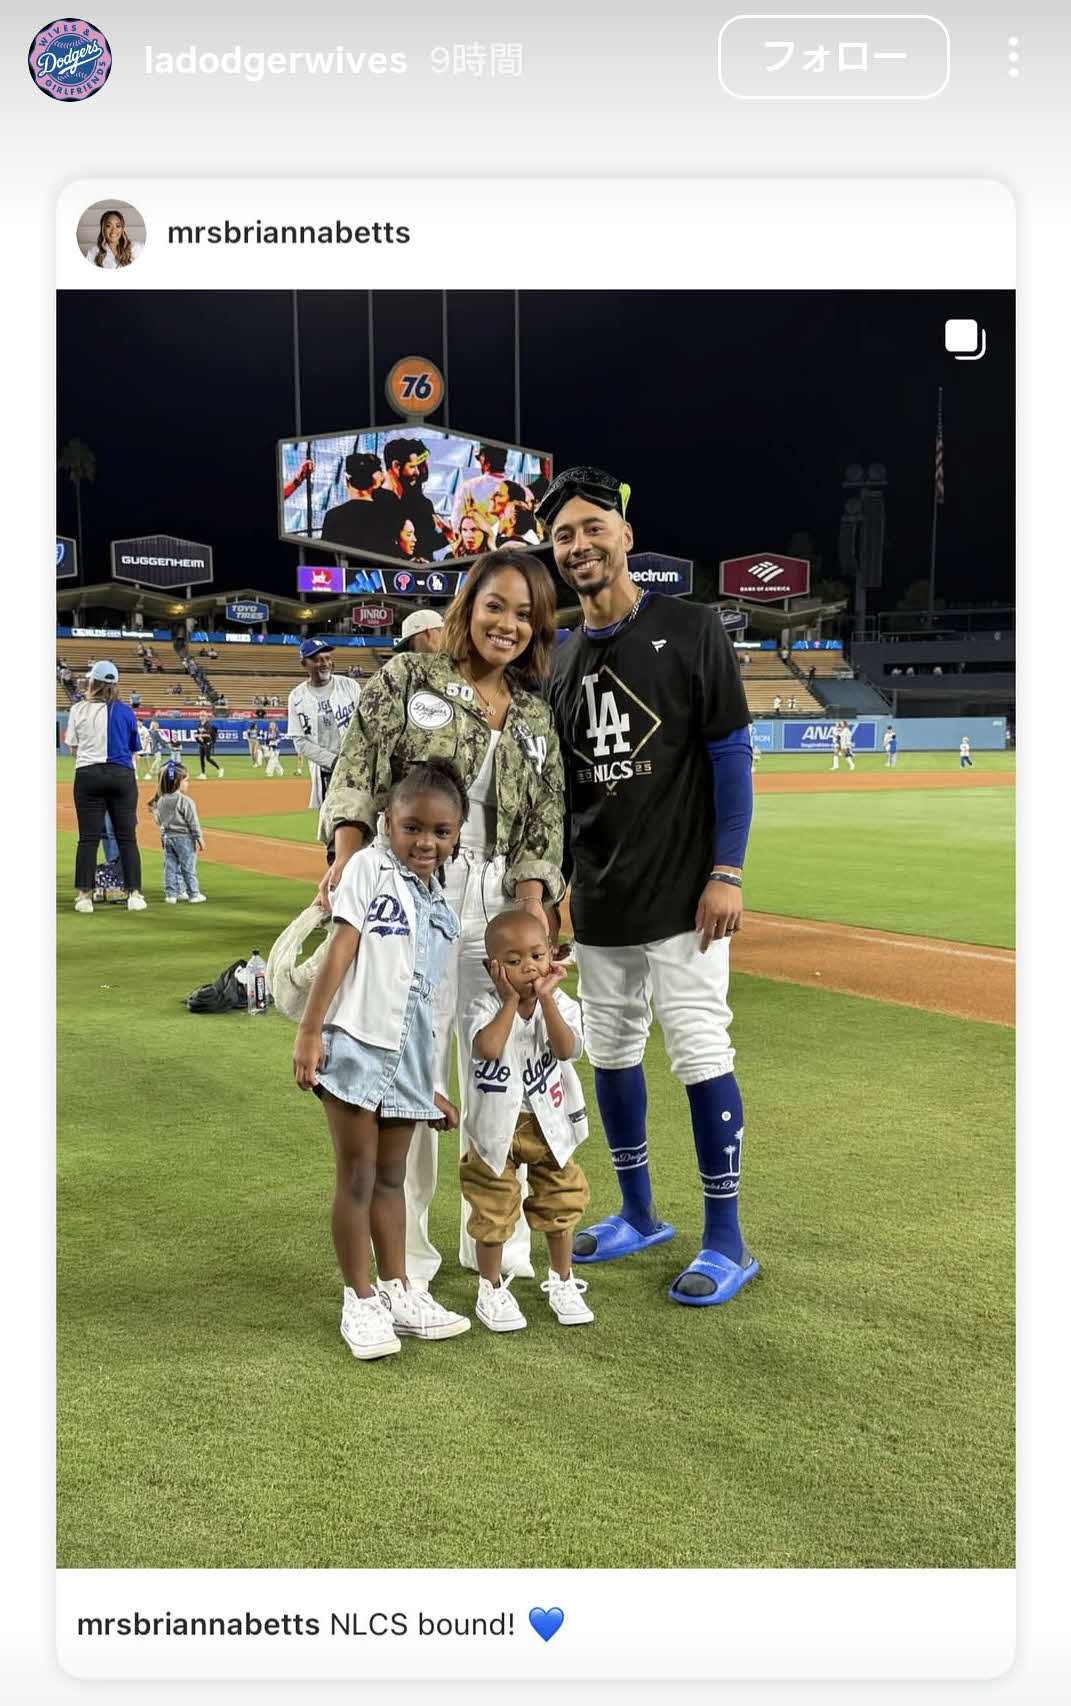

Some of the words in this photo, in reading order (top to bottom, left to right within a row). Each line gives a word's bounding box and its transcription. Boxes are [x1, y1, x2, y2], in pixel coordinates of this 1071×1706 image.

[400, 373, 433, 400] 76
[121, 556, 205, 568] GUGGENHEIM
[236, 612, 264, 620] TIRES
[360, 608, 388, 621] JINRO
[582, 673, 630, 757] LA
[593, 760, 634, 783] NLCS
[549, 1081, 563, 1109] 5
